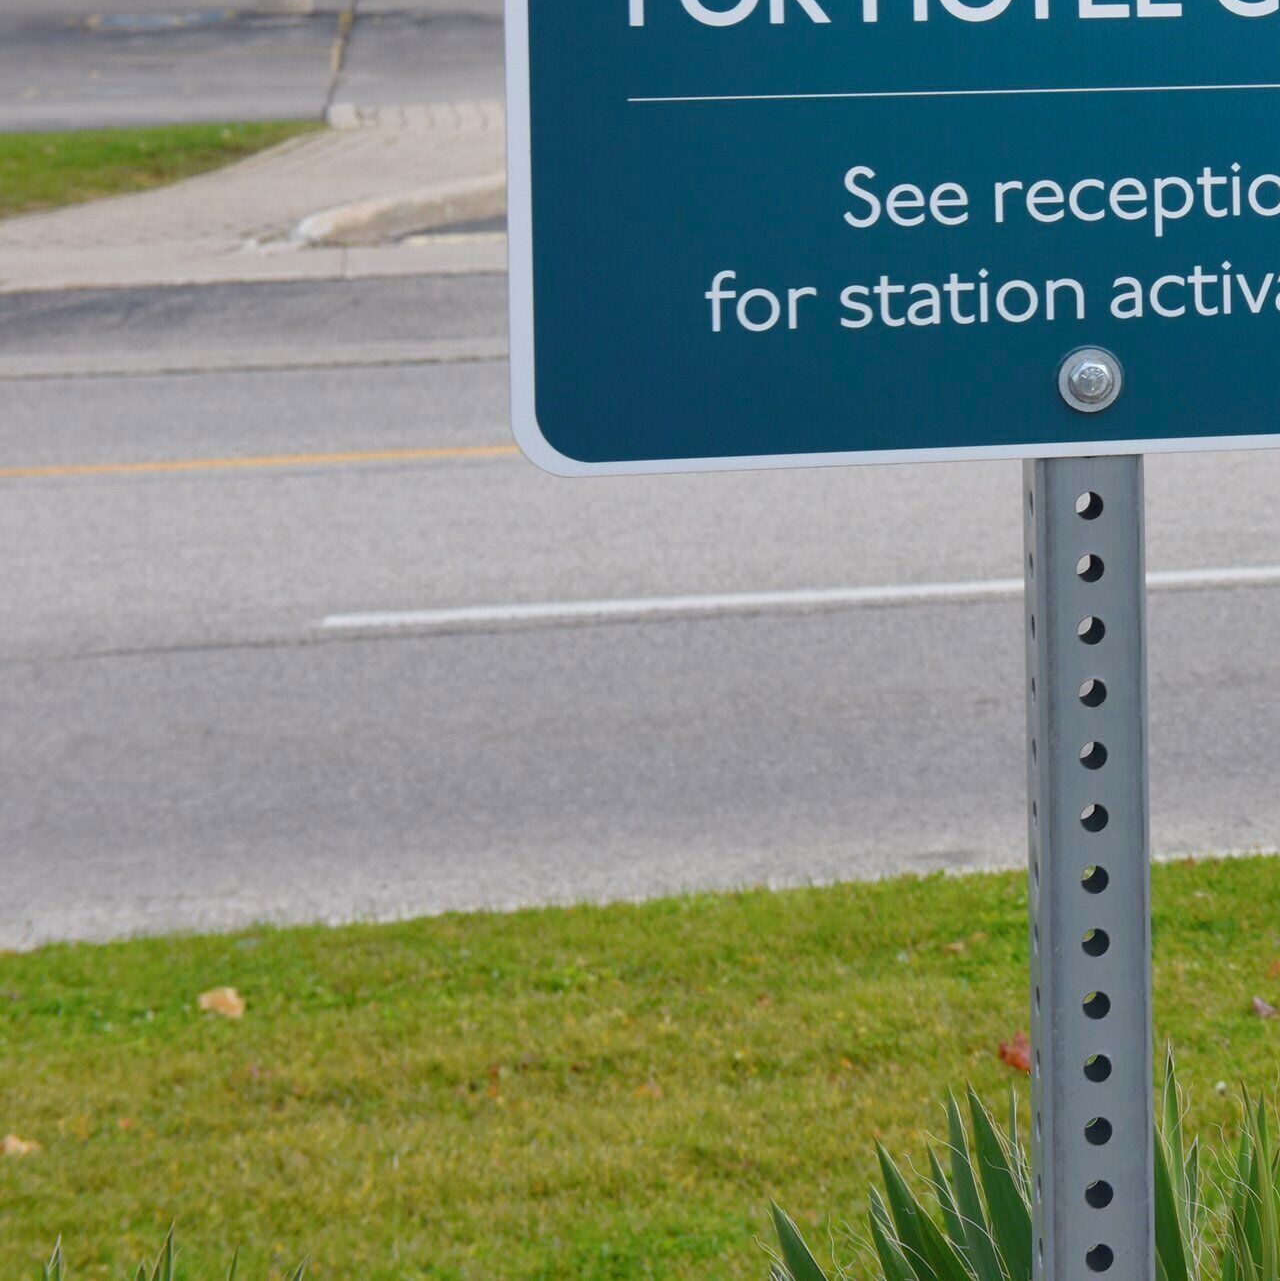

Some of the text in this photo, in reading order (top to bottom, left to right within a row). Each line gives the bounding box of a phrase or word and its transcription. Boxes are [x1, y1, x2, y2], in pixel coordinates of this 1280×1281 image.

[843, 164, 969, 228] See
[705, 270, 817, 332] for
[840, 268, 1086, 329] station
